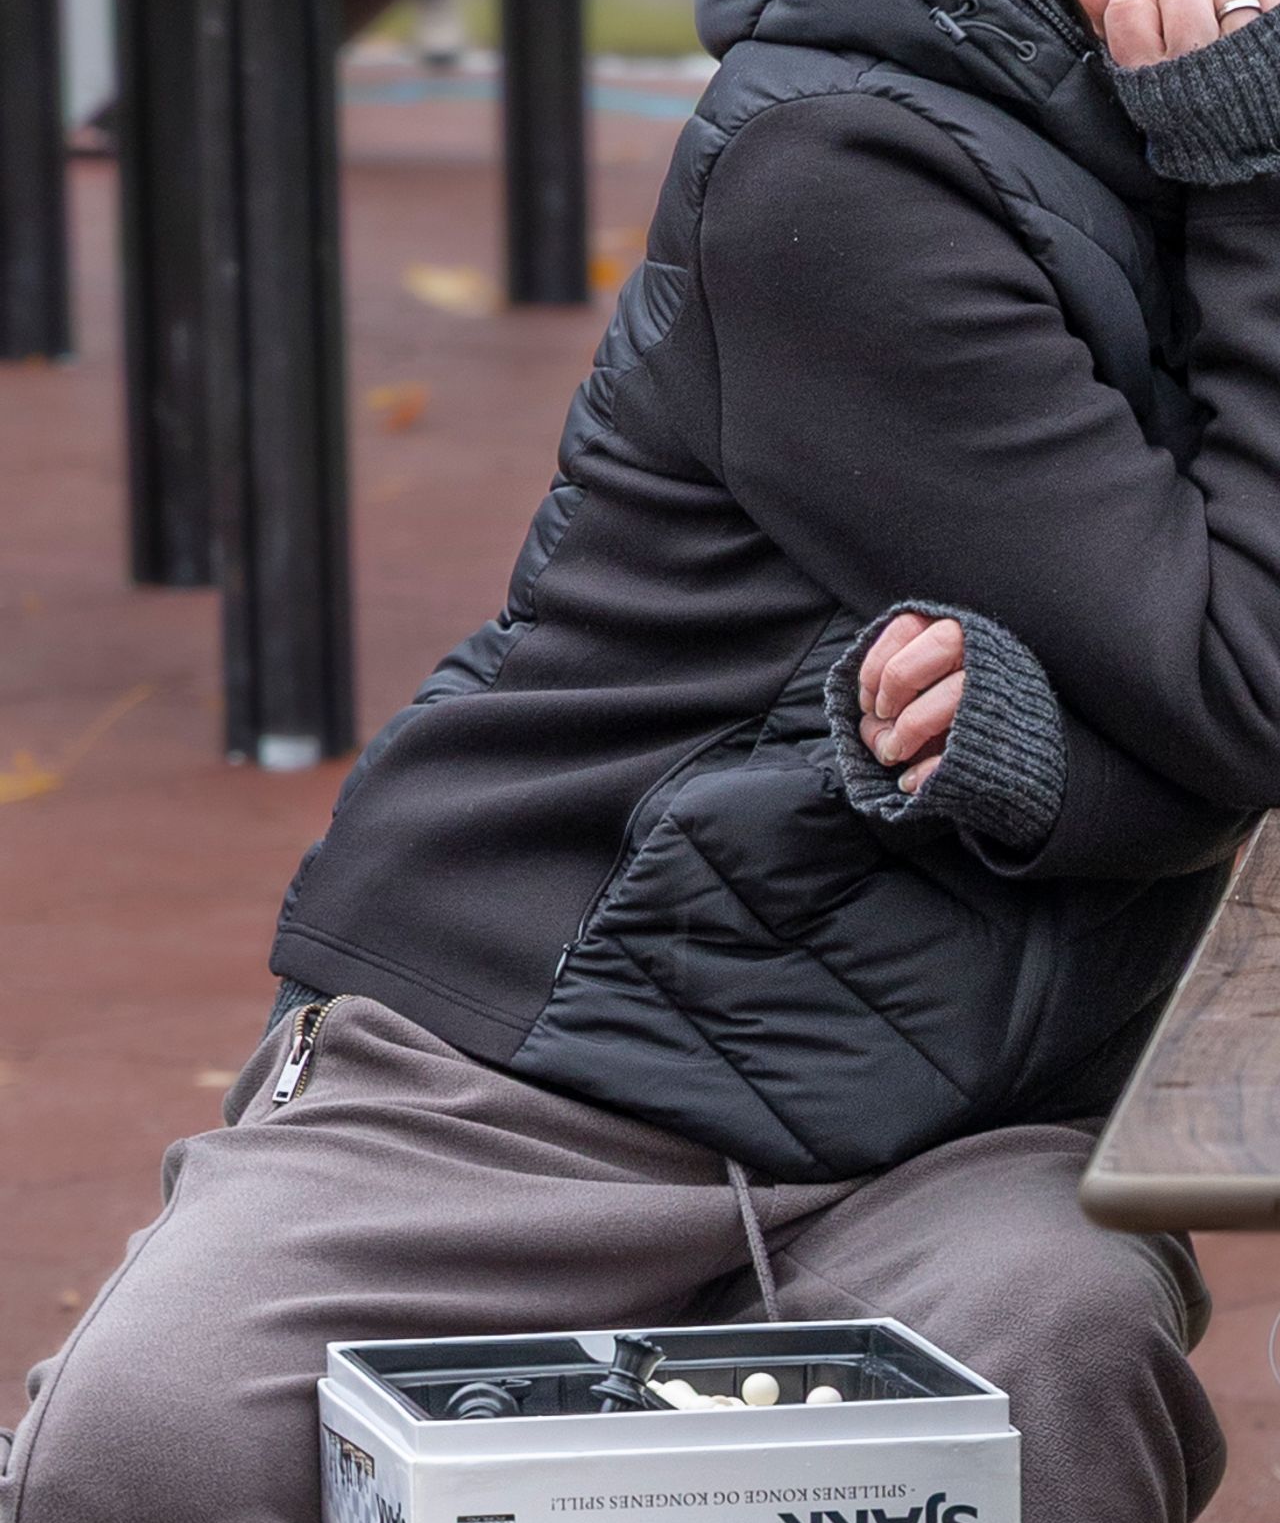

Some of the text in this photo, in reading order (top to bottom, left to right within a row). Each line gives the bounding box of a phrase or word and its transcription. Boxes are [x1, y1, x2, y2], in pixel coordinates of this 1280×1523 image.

[609, 1491, 709, 1510] KONGENES
[713, 1490, 740, 1506] OG
[744, 1487, 808, 1504] KONGE
[812, 1483, 907, 1502] SPILLENES
[551, 1495, 605, 1511] SPILL!
